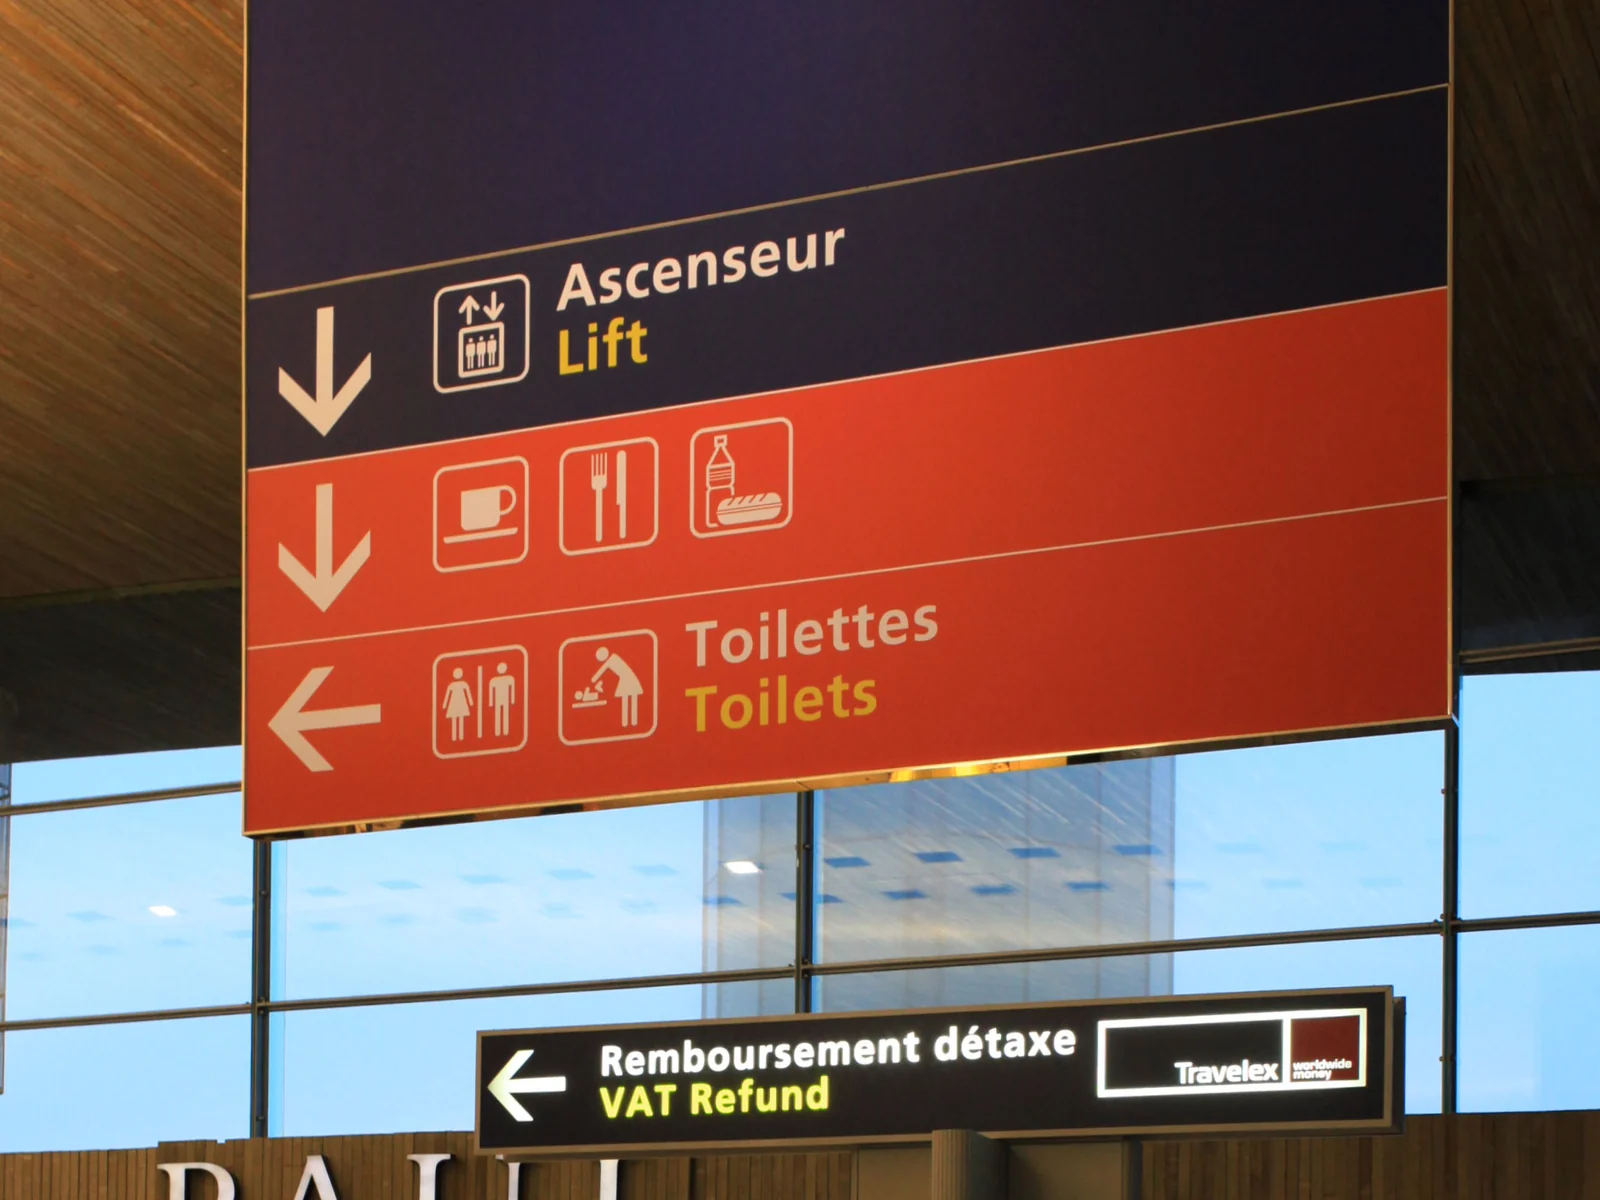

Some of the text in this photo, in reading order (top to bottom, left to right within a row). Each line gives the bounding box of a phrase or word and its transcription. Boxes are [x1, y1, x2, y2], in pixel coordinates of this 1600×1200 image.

[556, 228, 845, 311] Ascenseur
[559, 317, 648, 375] Lift
[685, 604, 939, 667] Toilettes
[685, 674, 877, 732] Toilets
[601, 1025, 1076, 1077] Remboursement détaxe
[1174, 1059, 1279, 1085] Travelex
[1292, 1058, 1352, 1071] worldwide
[1292, 1069, 1332, 1081] money
[599, 1075, 829, 1118] VAT Refund
